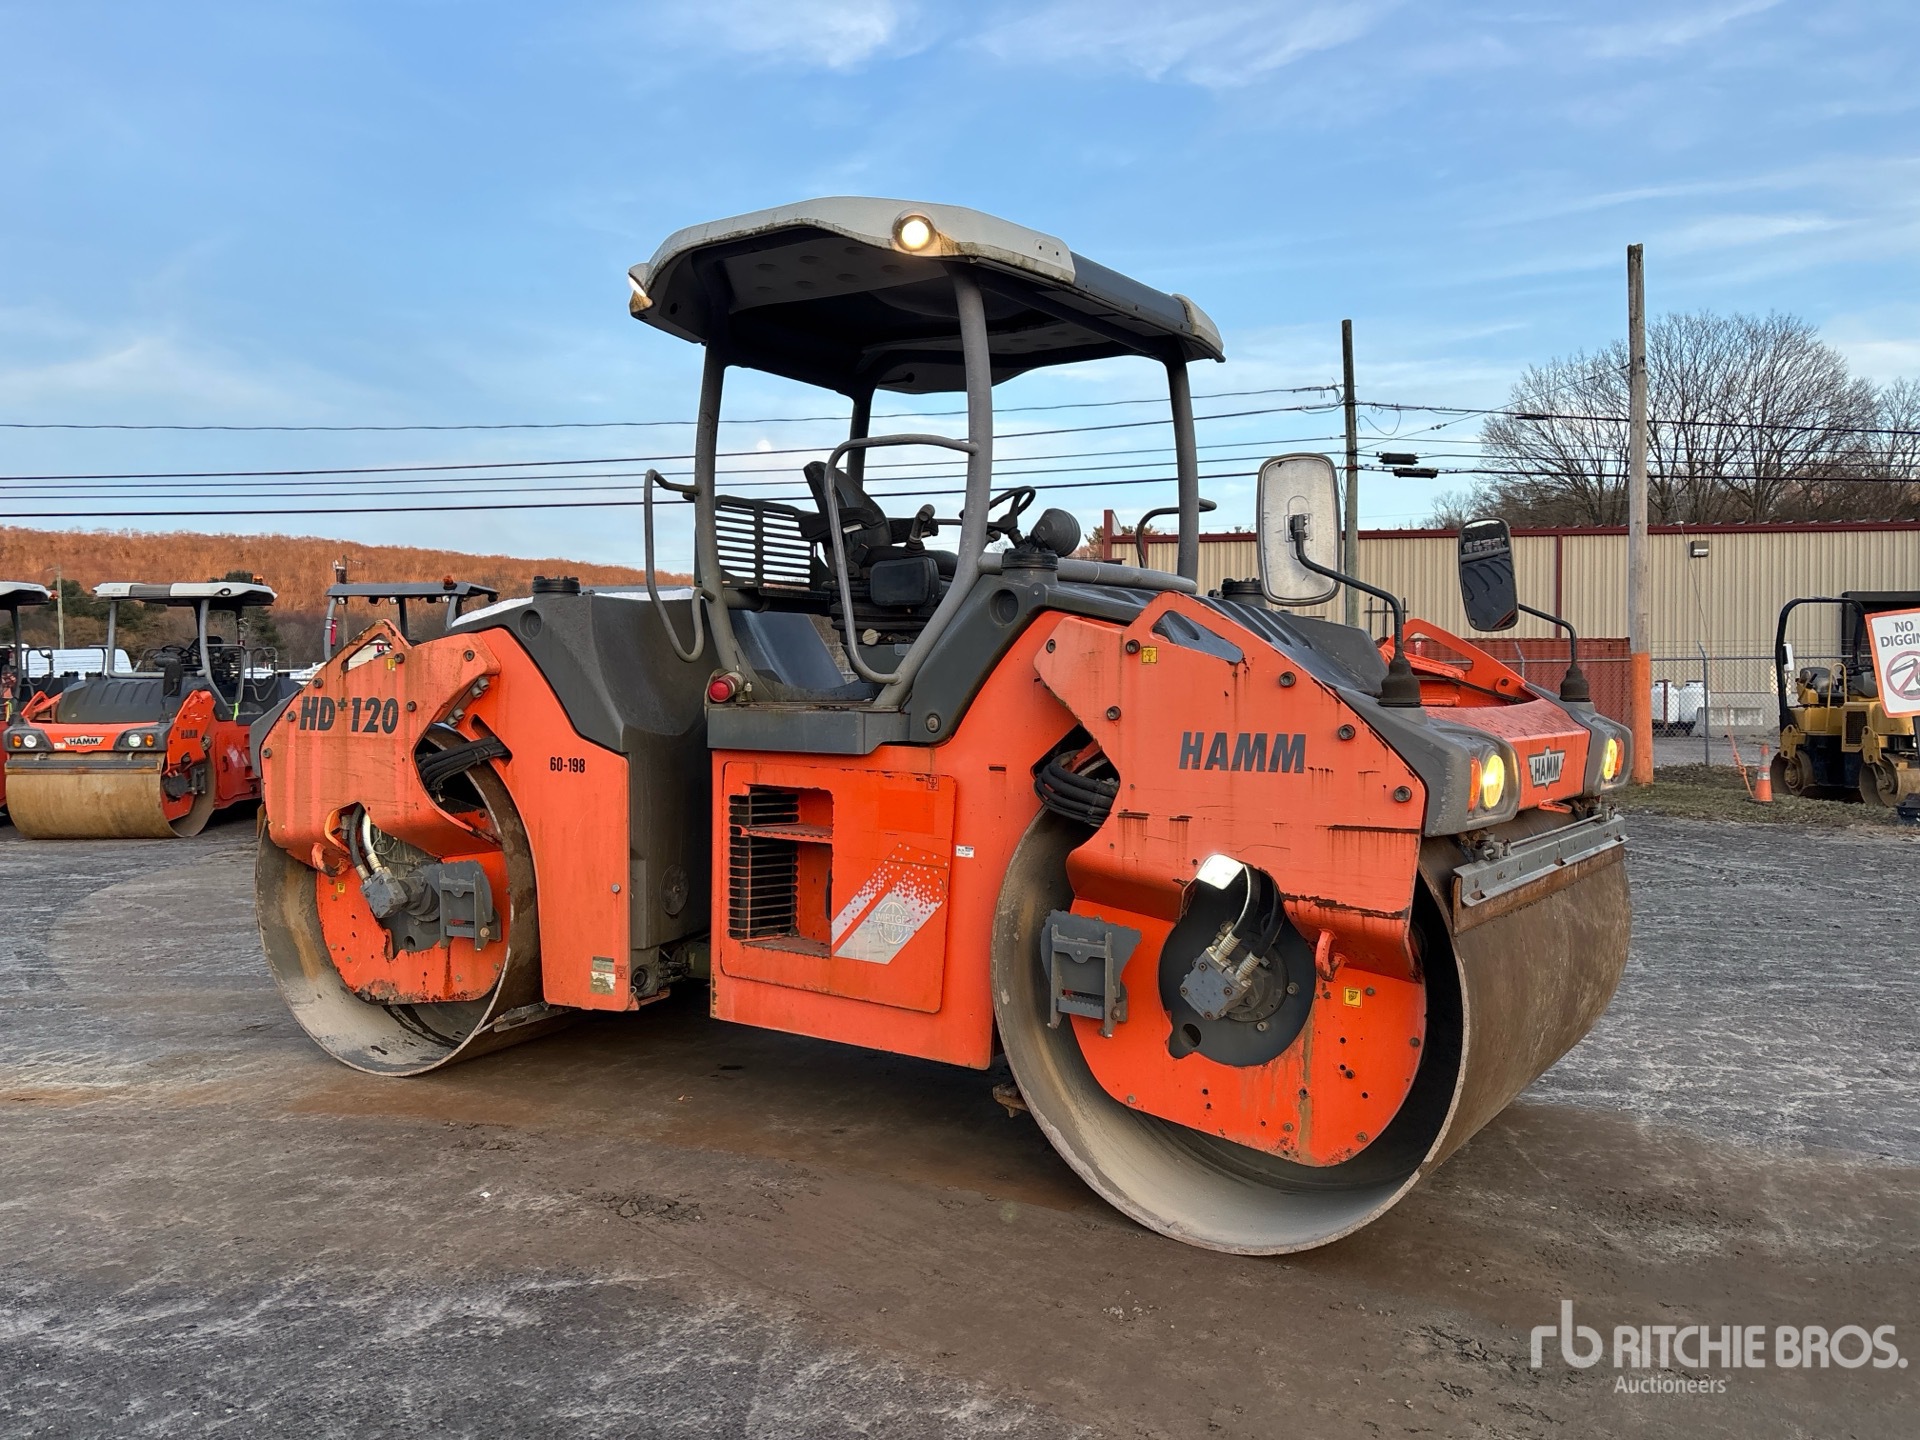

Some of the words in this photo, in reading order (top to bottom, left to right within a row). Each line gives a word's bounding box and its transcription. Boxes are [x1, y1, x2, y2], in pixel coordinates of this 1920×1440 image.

[1894, 620, 1914, 633] NO
[351, 697, 399, 735] 120
[69, 737, 99, 746] HAMM
[1178, 731, 1307, 774] HAMM
[550, 756, 585, 773] 60-198
[1534, 754, 1560, 783] HAMM
[877, 923, 911, 933] GROUP
